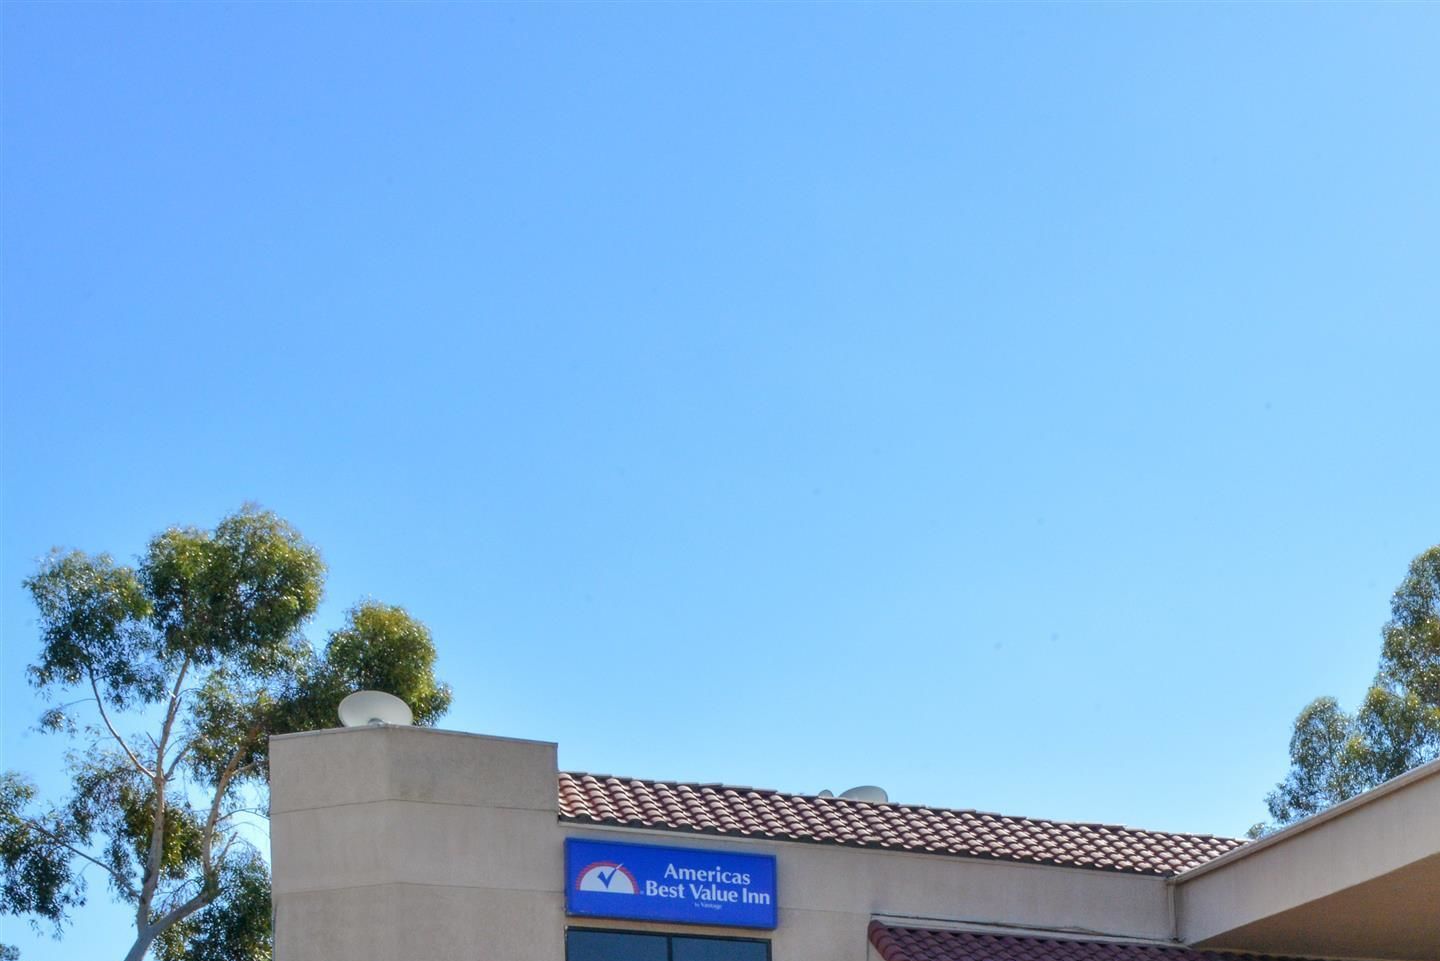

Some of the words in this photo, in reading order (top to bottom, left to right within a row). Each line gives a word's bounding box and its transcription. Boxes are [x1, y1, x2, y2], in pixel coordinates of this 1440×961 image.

[664, 863, 751, 885] Americas
[646, 880, 685, 899] Best
[689, 884, 738, 903] Value
[742, 888, 770, 905] Inn
